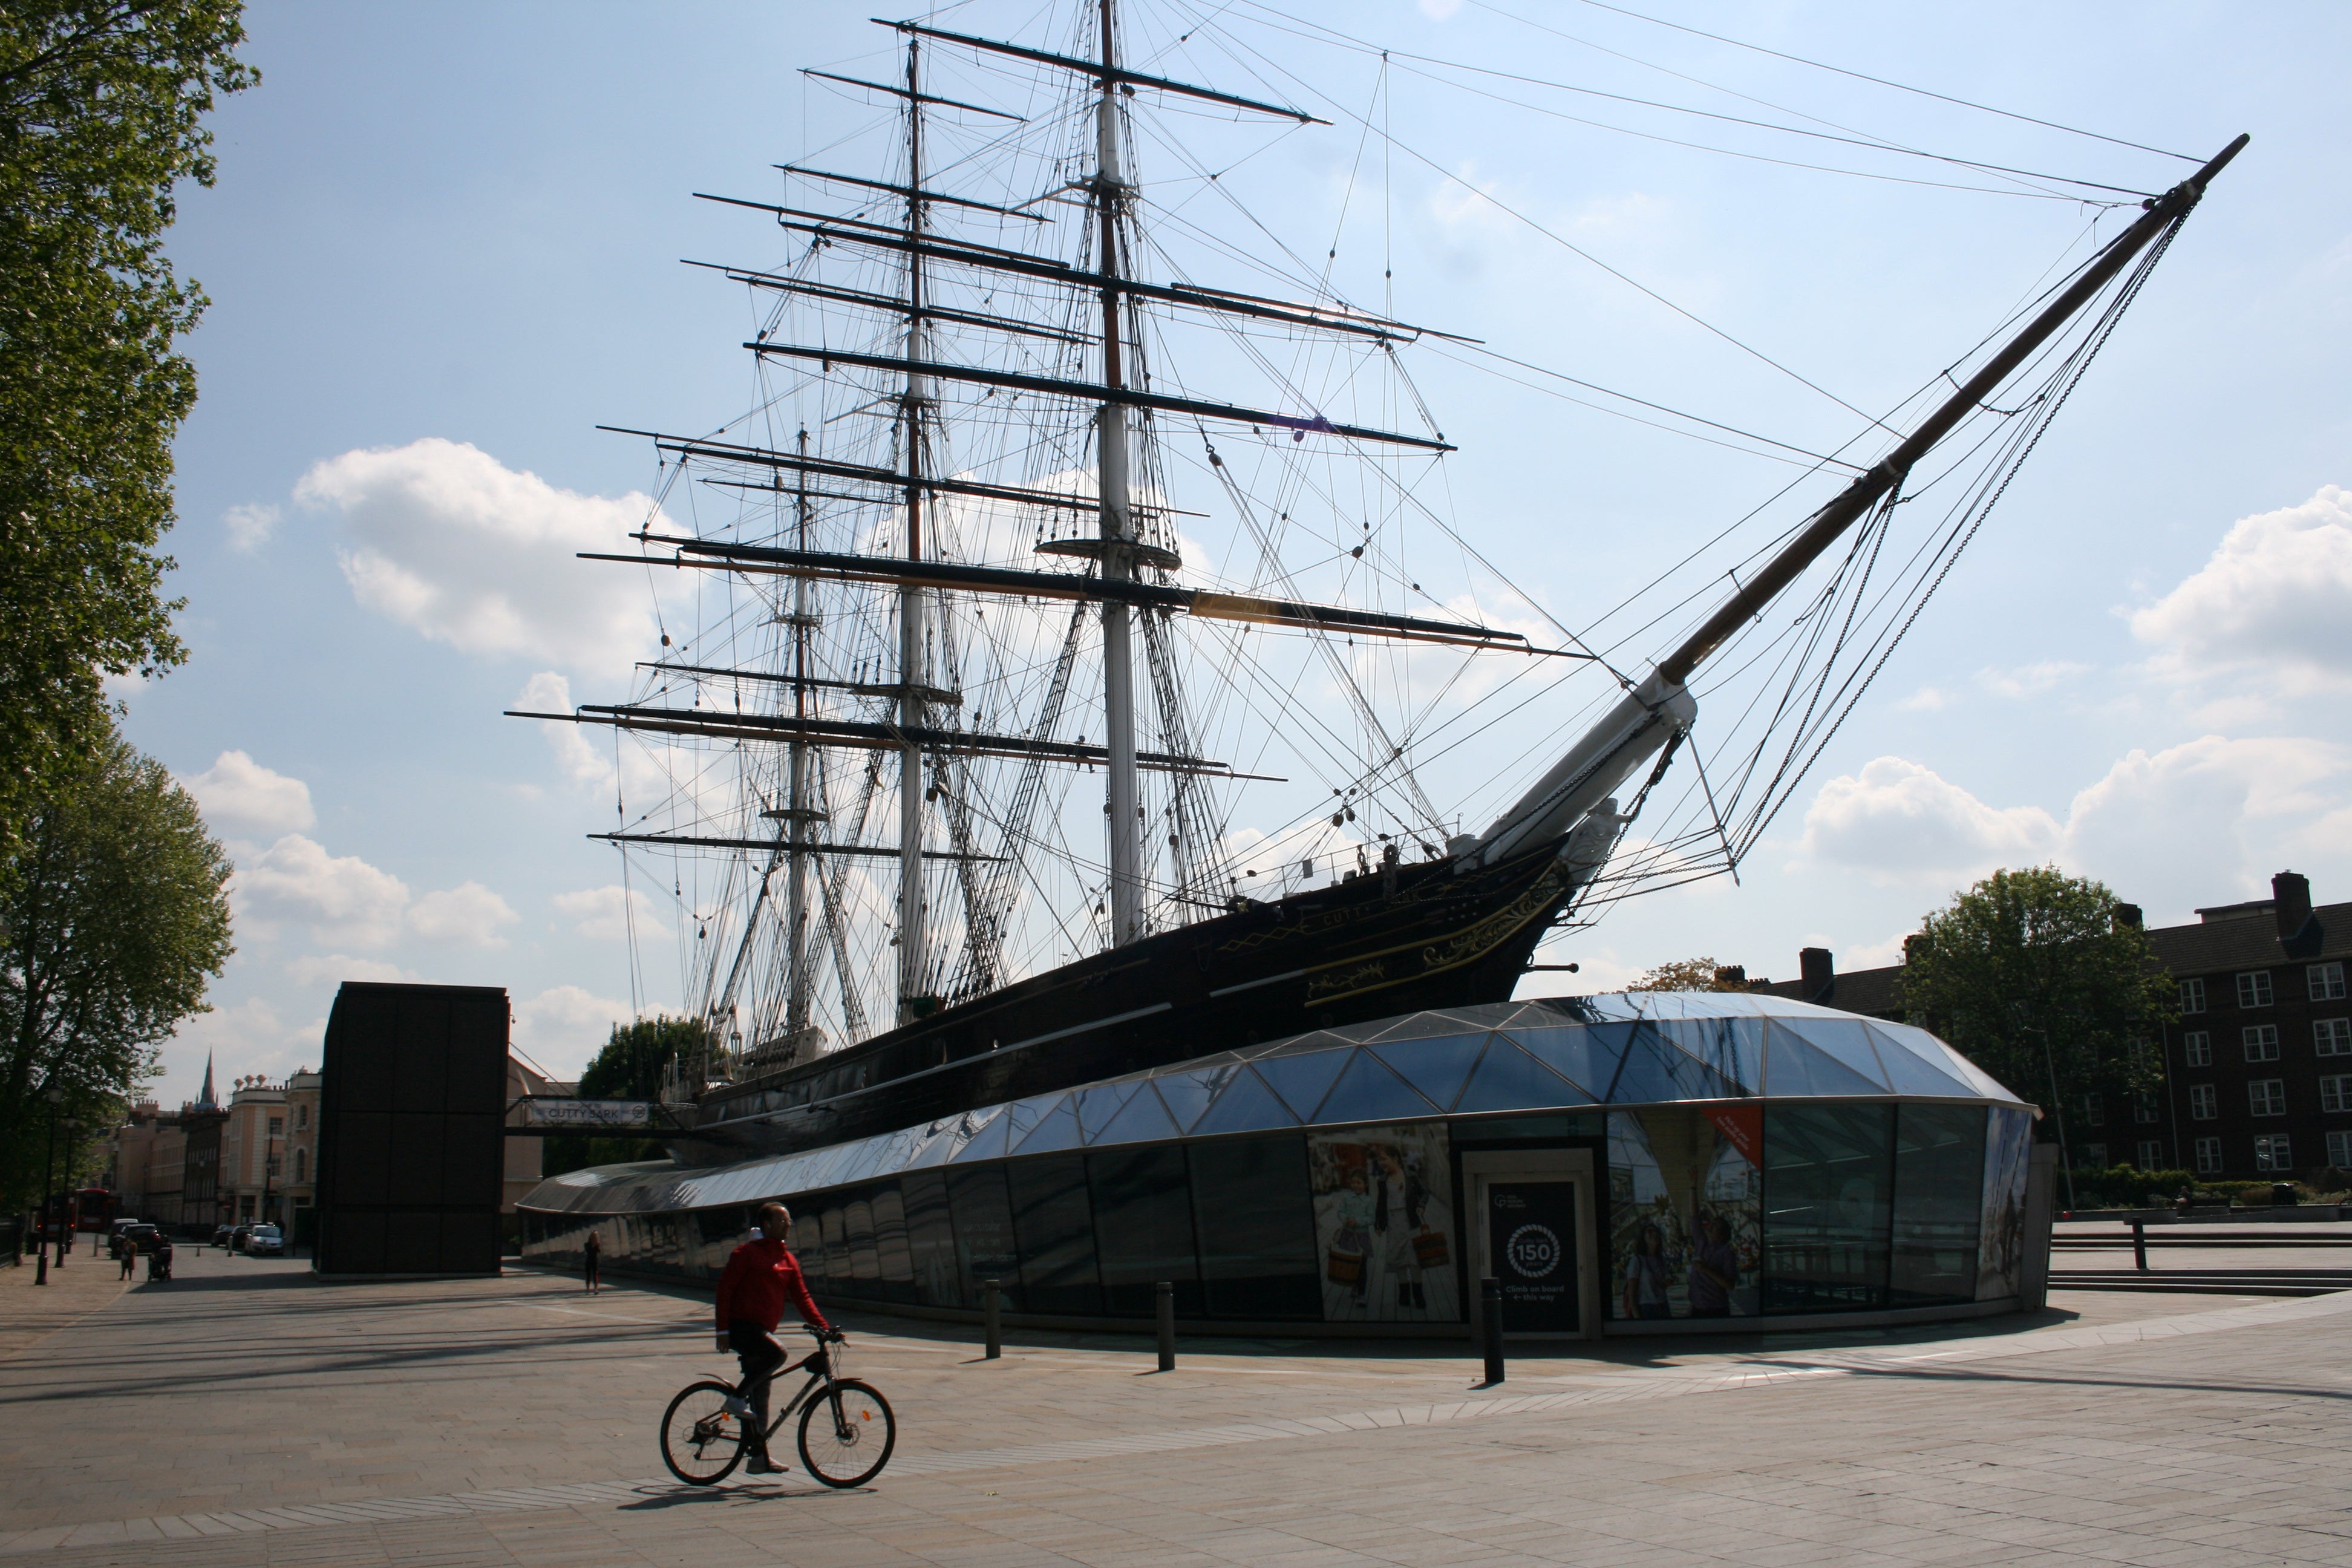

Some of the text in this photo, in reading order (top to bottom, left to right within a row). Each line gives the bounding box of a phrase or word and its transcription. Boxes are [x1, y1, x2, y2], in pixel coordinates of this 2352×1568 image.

[549, 1108, 618, 1119] CUTTY SARK
[1516, 1244, 1550, 1261] 150
[1505, 1284, 1528, 1293] Climb
[1541, 1284, 1564, 1293] board
[1523, 1293, 1538, 1301] this
